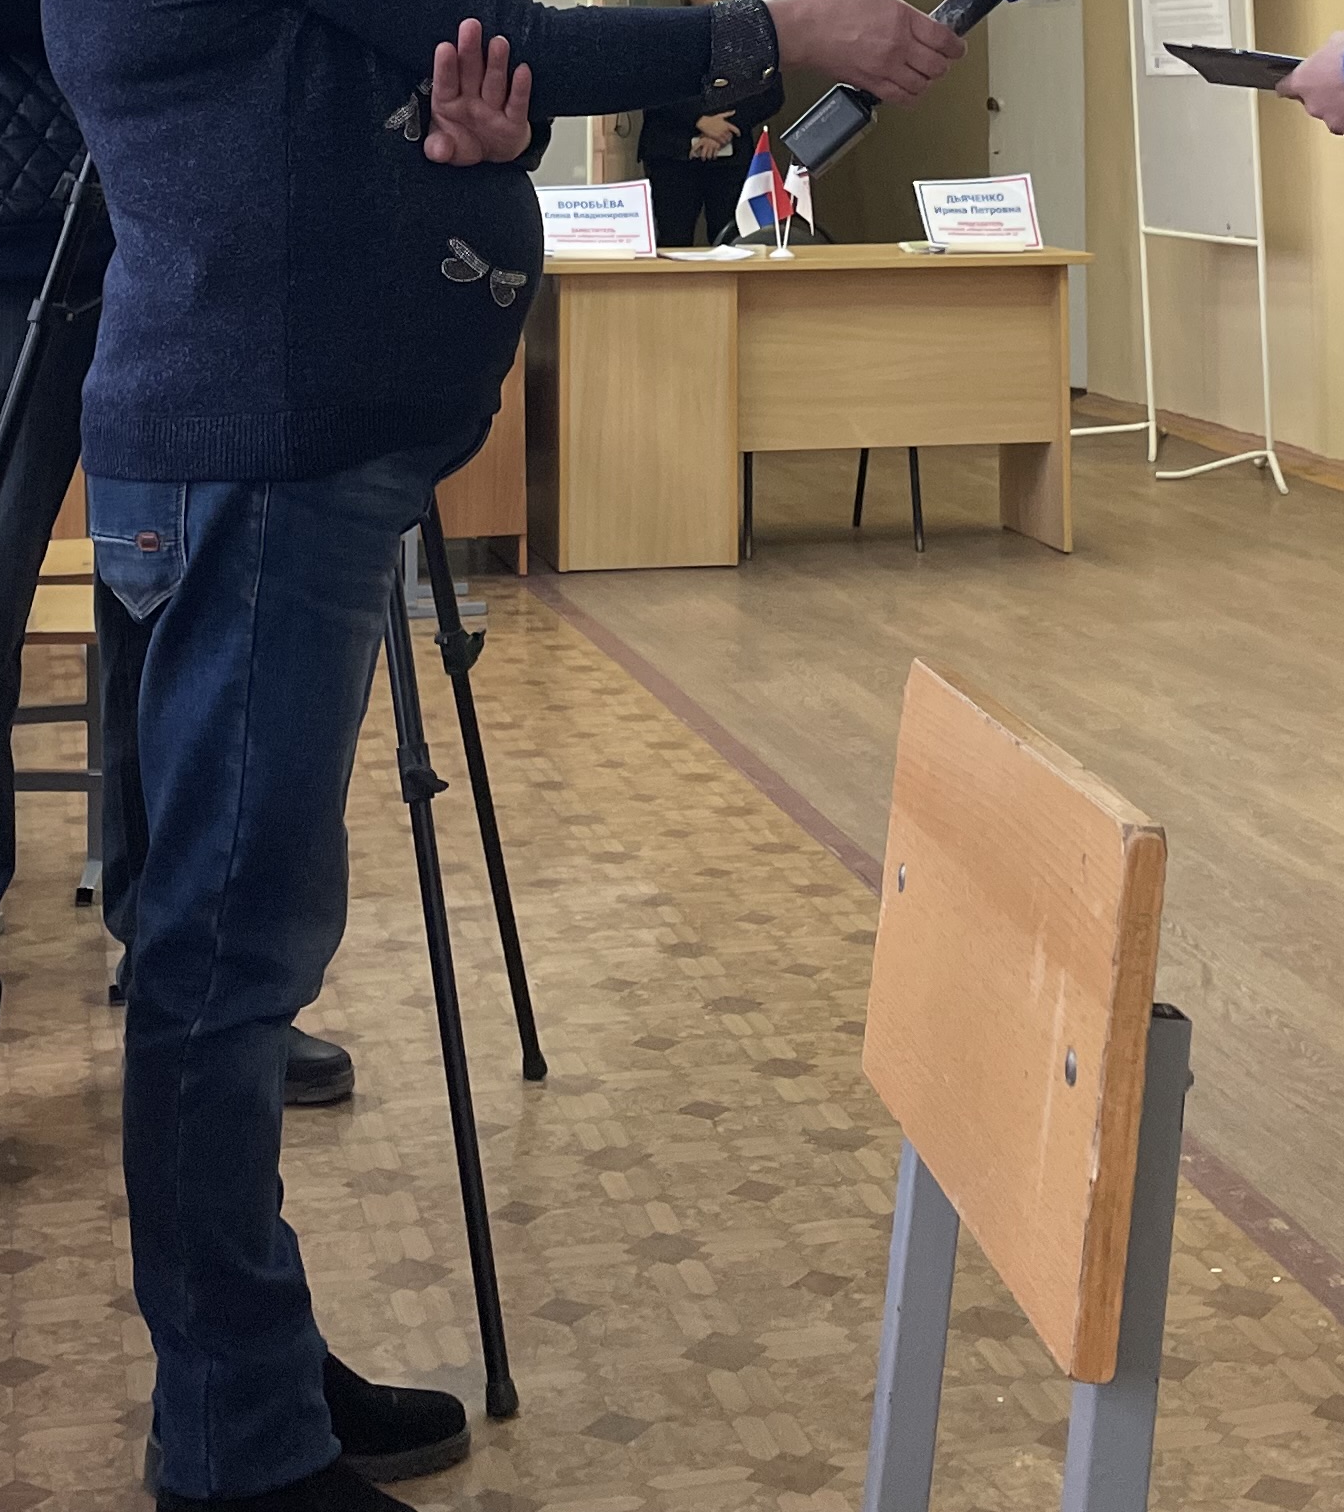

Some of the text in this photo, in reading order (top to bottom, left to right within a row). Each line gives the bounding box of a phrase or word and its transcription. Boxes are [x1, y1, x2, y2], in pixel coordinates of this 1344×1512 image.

[557, 198, 624, 209] ВОРОБЬЁВА
[946, 193, 1005, 204] ДЬЯЧЕНКО
[544, 211, 640, 220] Елена Владимировна
[934, 205, 1021, 216] Ирина Петровна
